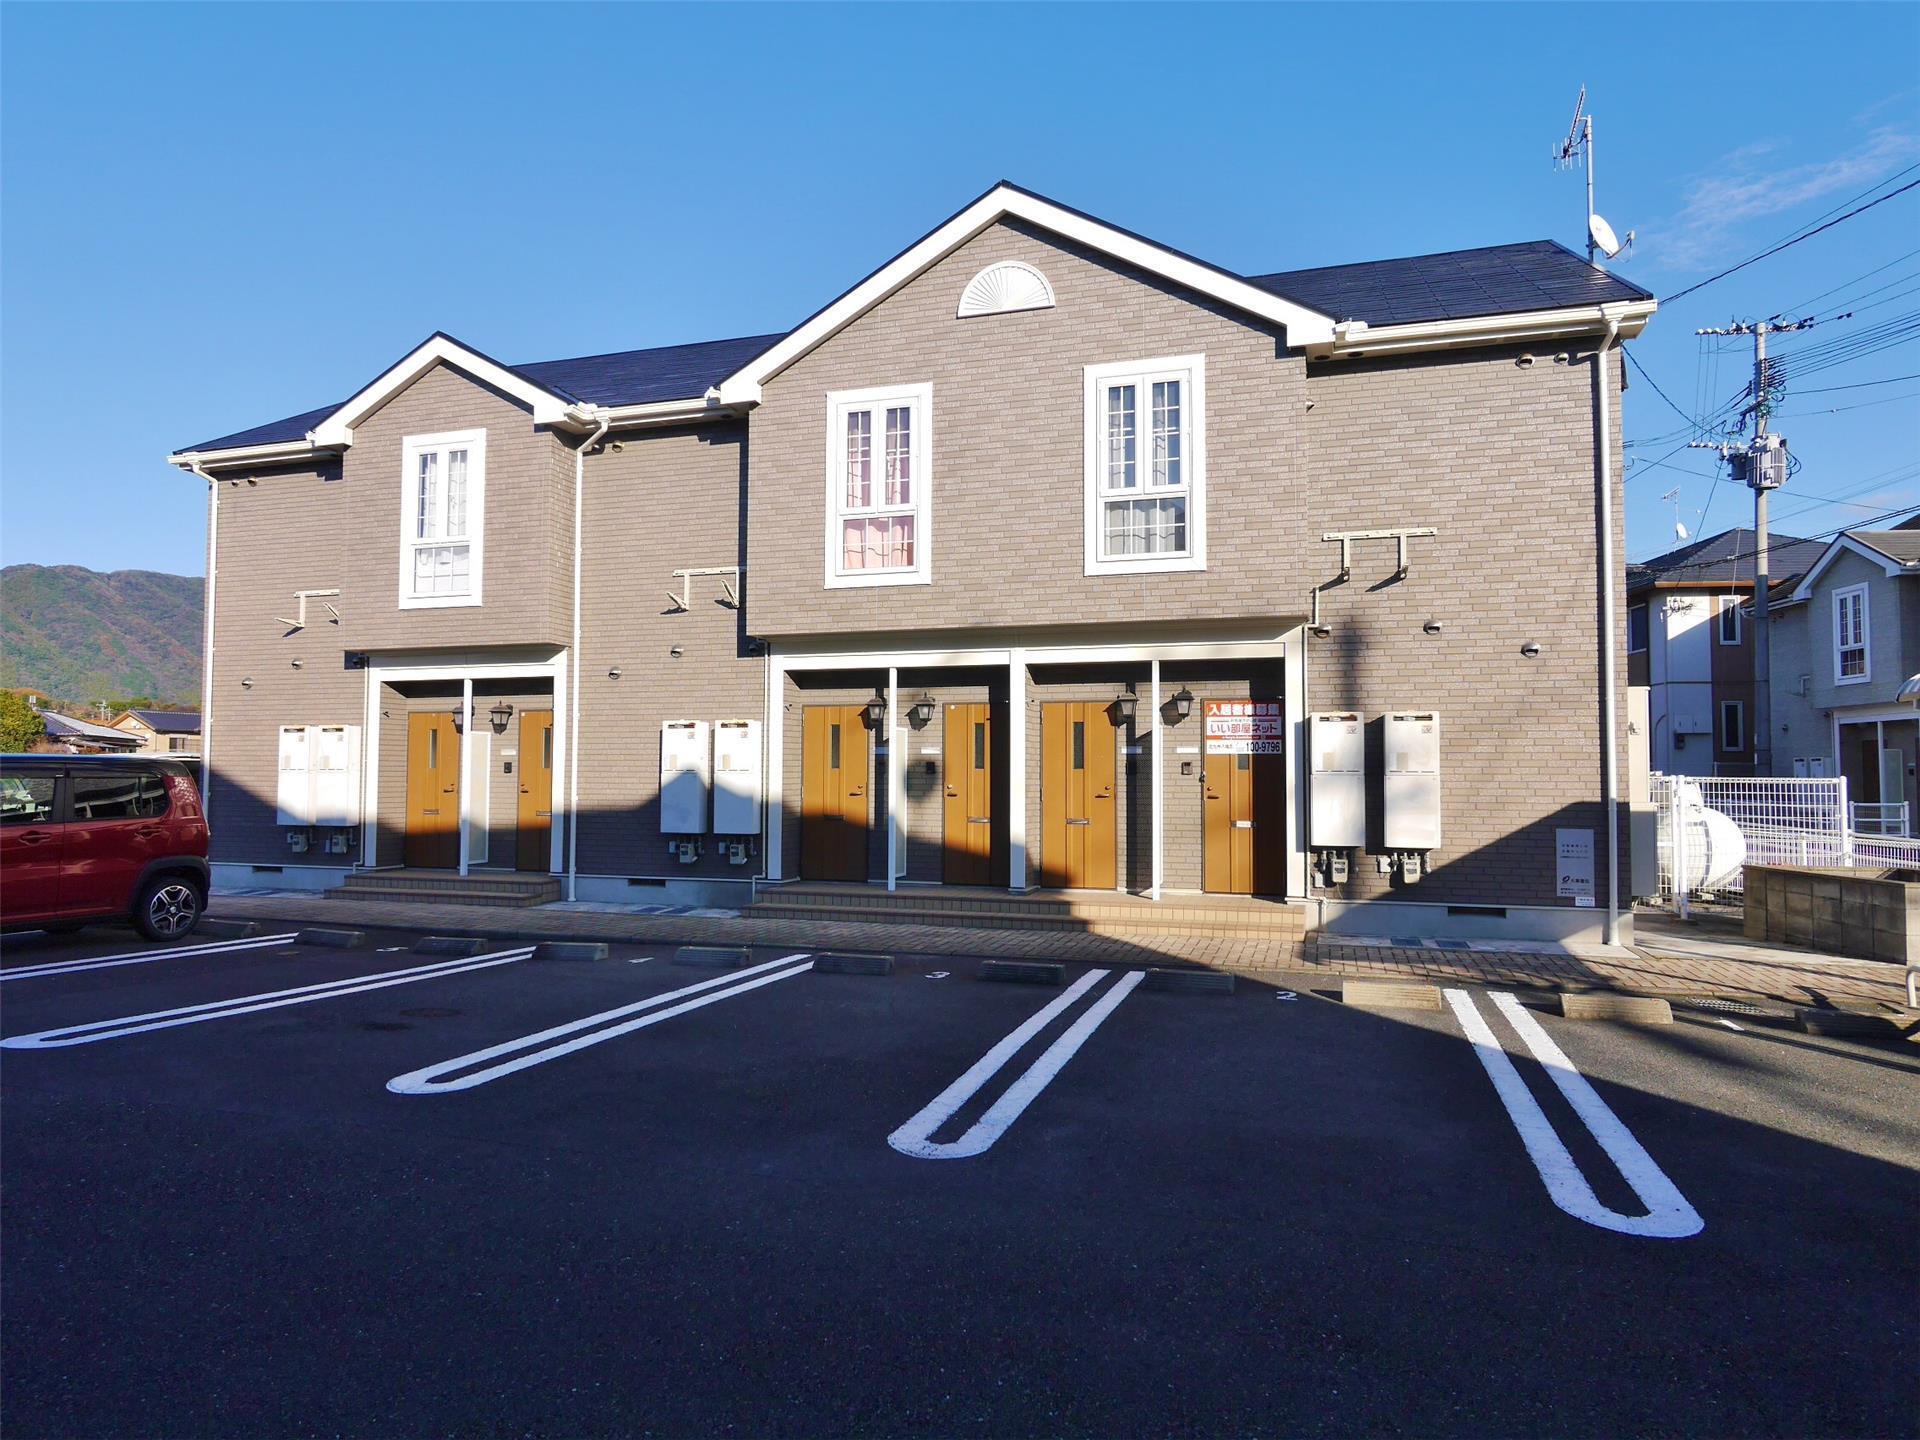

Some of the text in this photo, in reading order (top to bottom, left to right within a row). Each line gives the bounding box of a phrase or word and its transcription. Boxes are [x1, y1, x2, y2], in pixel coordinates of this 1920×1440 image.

[1210, 723, 1278, 734] いい部屋ネット
[1276, 990, 1299, 1001] 2
